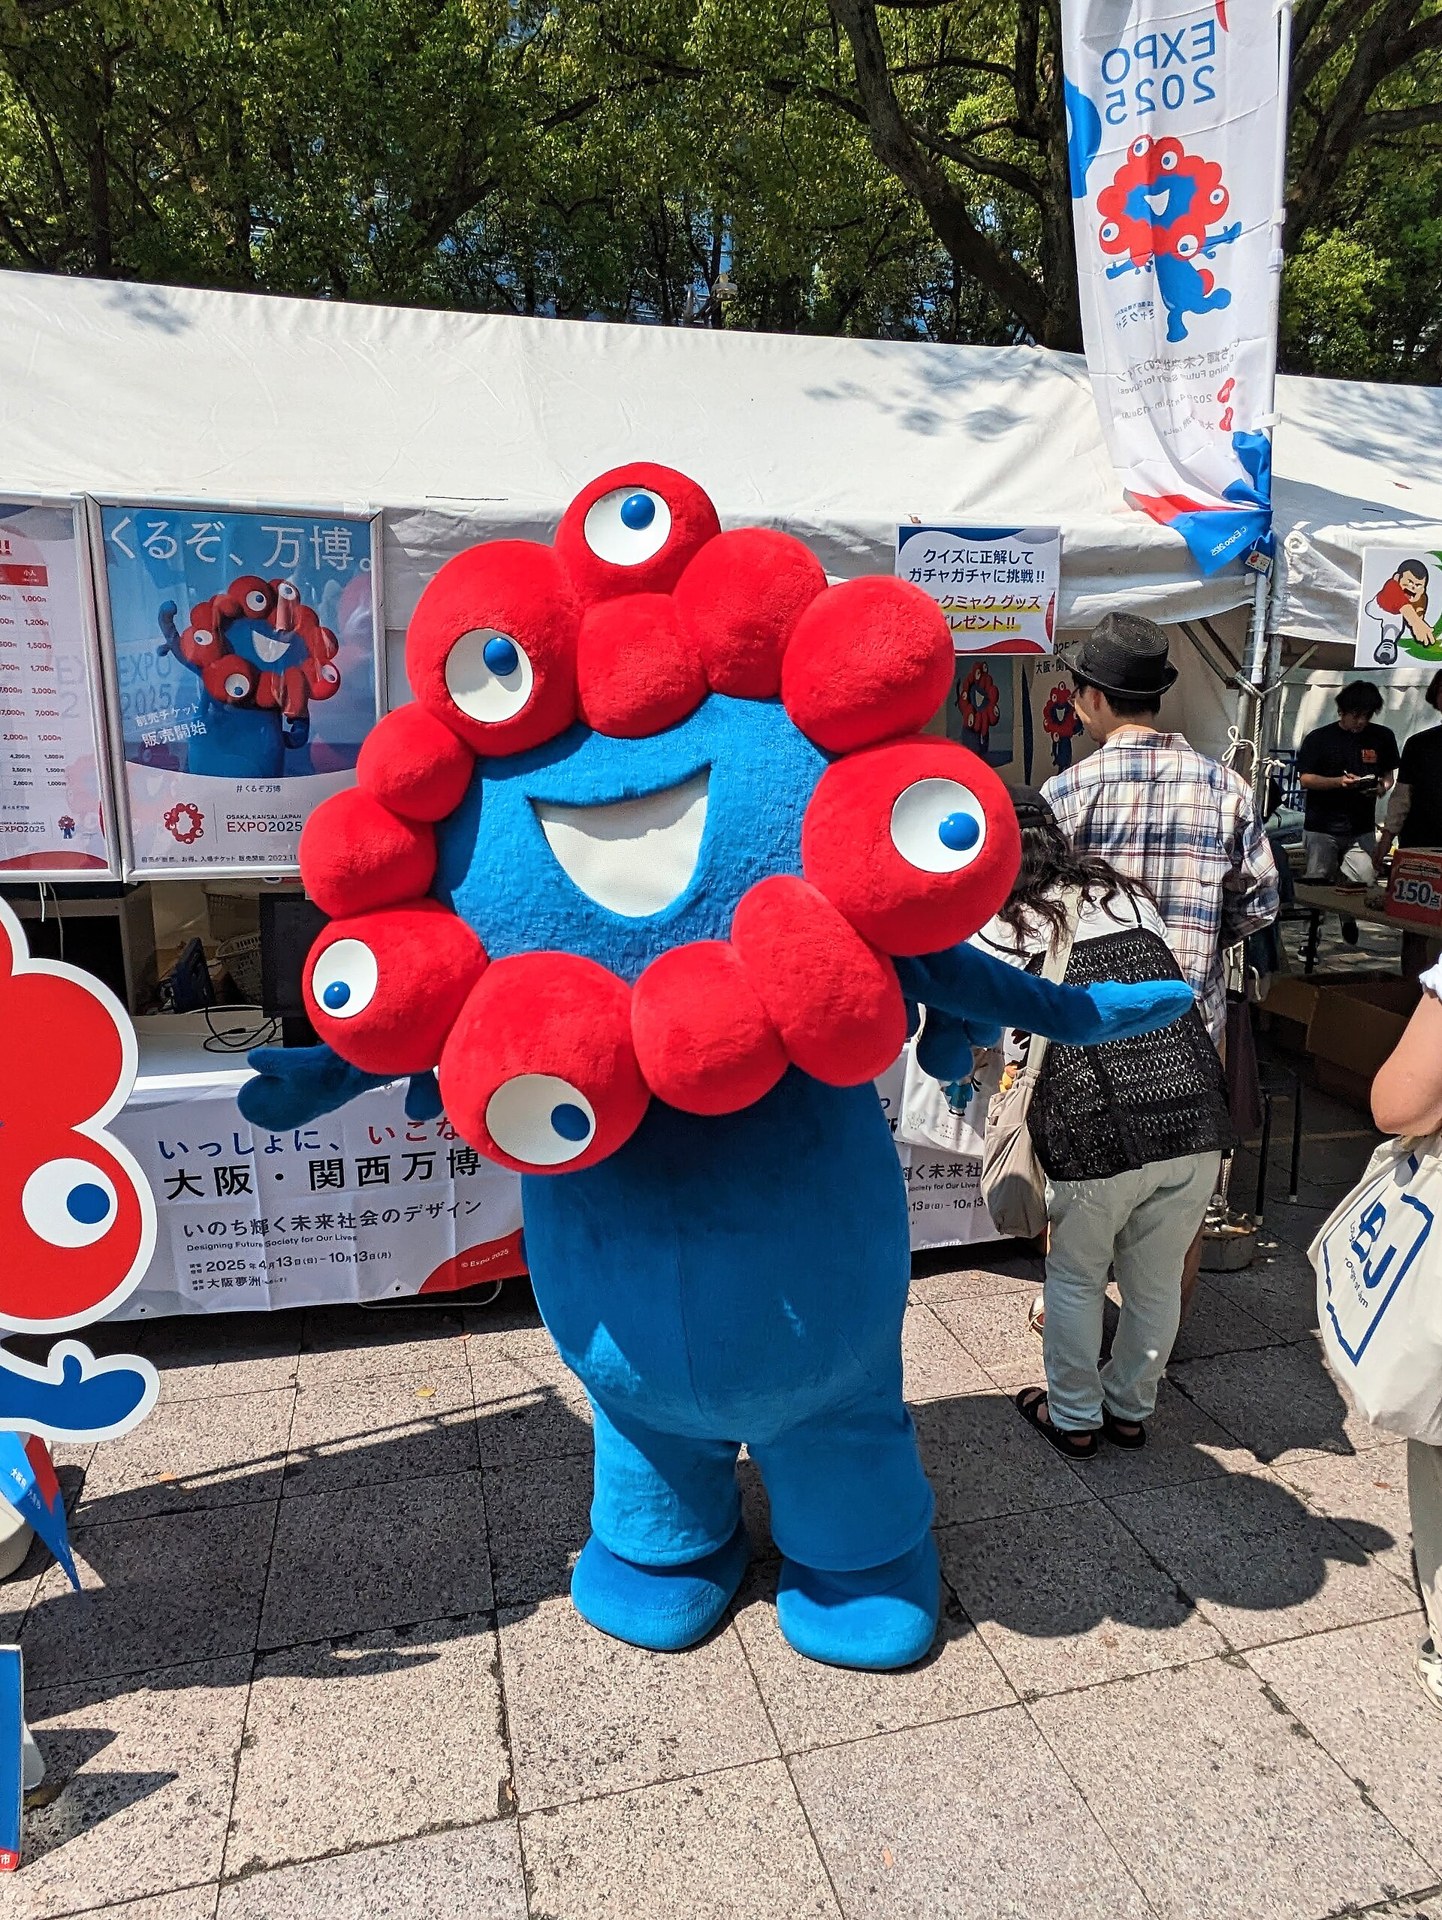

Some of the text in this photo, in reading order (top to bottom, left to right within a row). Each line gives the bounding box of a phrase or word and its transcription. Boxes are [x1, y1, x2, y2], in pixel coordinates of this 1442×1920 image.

[109, 515, 372, 573] くるぞ、万博。
[923, 549, 1035, 565] クイズに正解して
[935, 594, 1042, 610] クミャク グッズ
[141, 720, 208, 748] 販売開始
[227, 821, 303, 833] EXPO2025
[158, 1129, 341, 1160] いっしょに、
[163, 1147, 483, 1201] 大阪・関西万博
[183, 1199, 483, 1238] いのち輝く未来社会のデザイン
[187, 1233, 358, 1252] Designing Future Society for Our Lives
[470, 1257, 491, 1268] Expo
[491, 1249, 509, 1260] 2025
